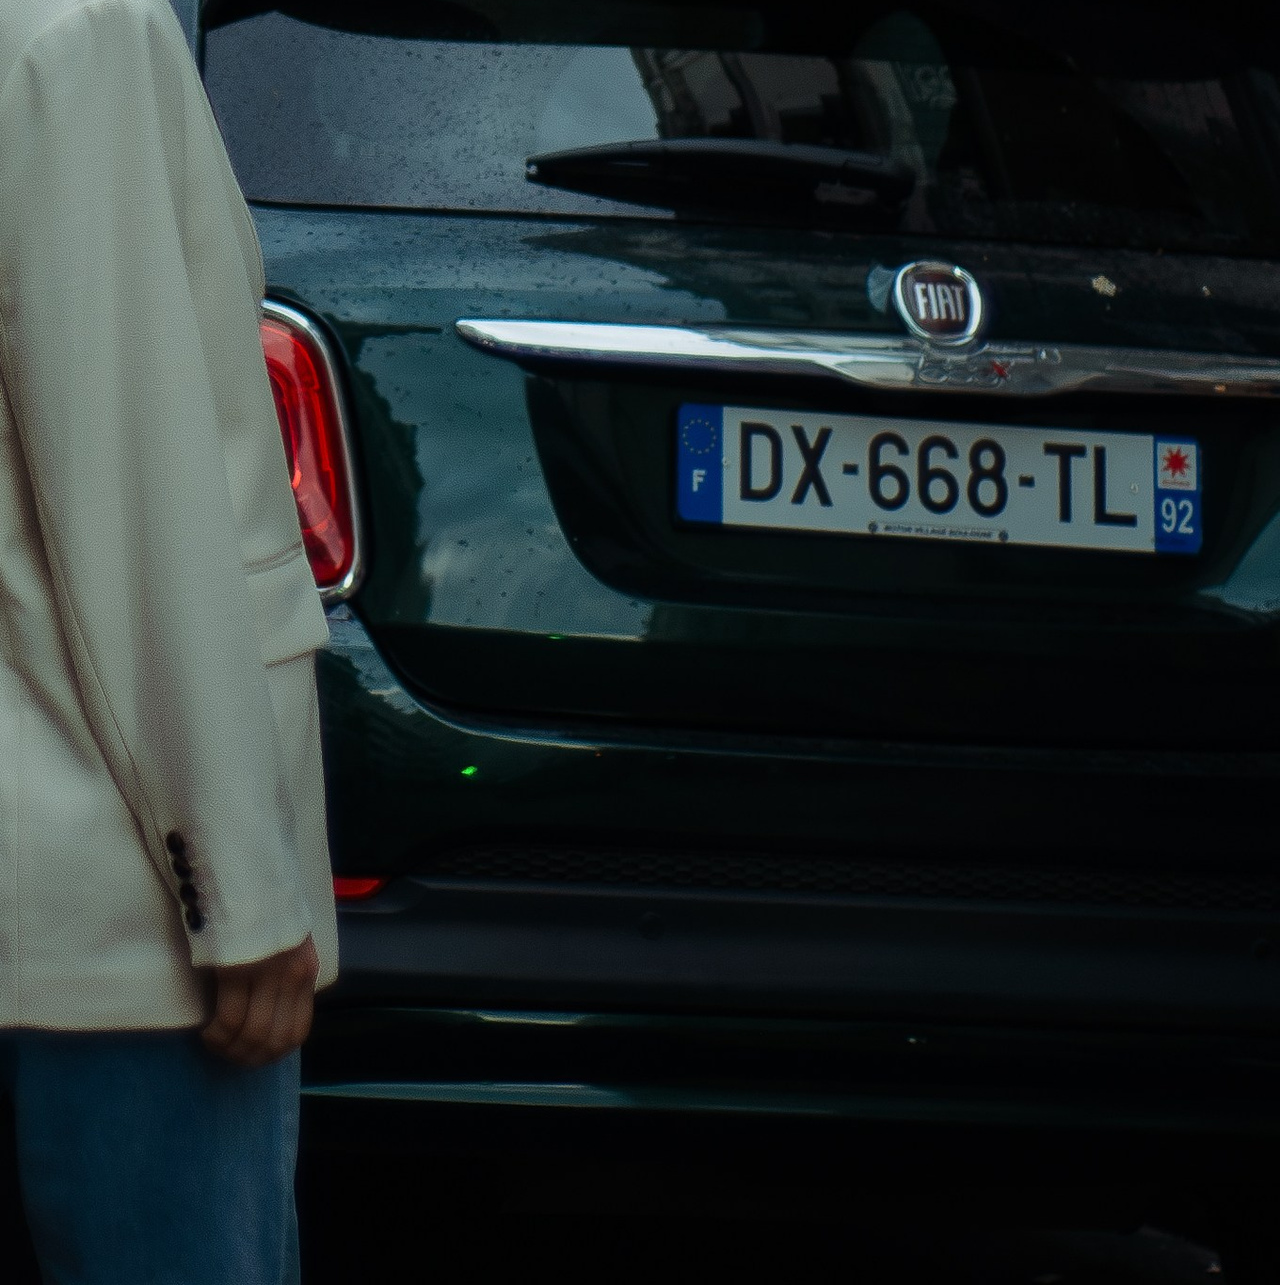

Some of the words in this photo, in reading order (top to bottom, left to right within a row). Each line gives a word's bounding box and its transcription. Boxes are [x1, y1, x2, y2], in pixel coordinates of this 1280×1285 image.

[914, 281, 965, 322] FIAT
[692, 468, 706, 493] F
[739, 420, 1138, 528] DX-668-TL
[1161, 497, 1194, 534] 92
